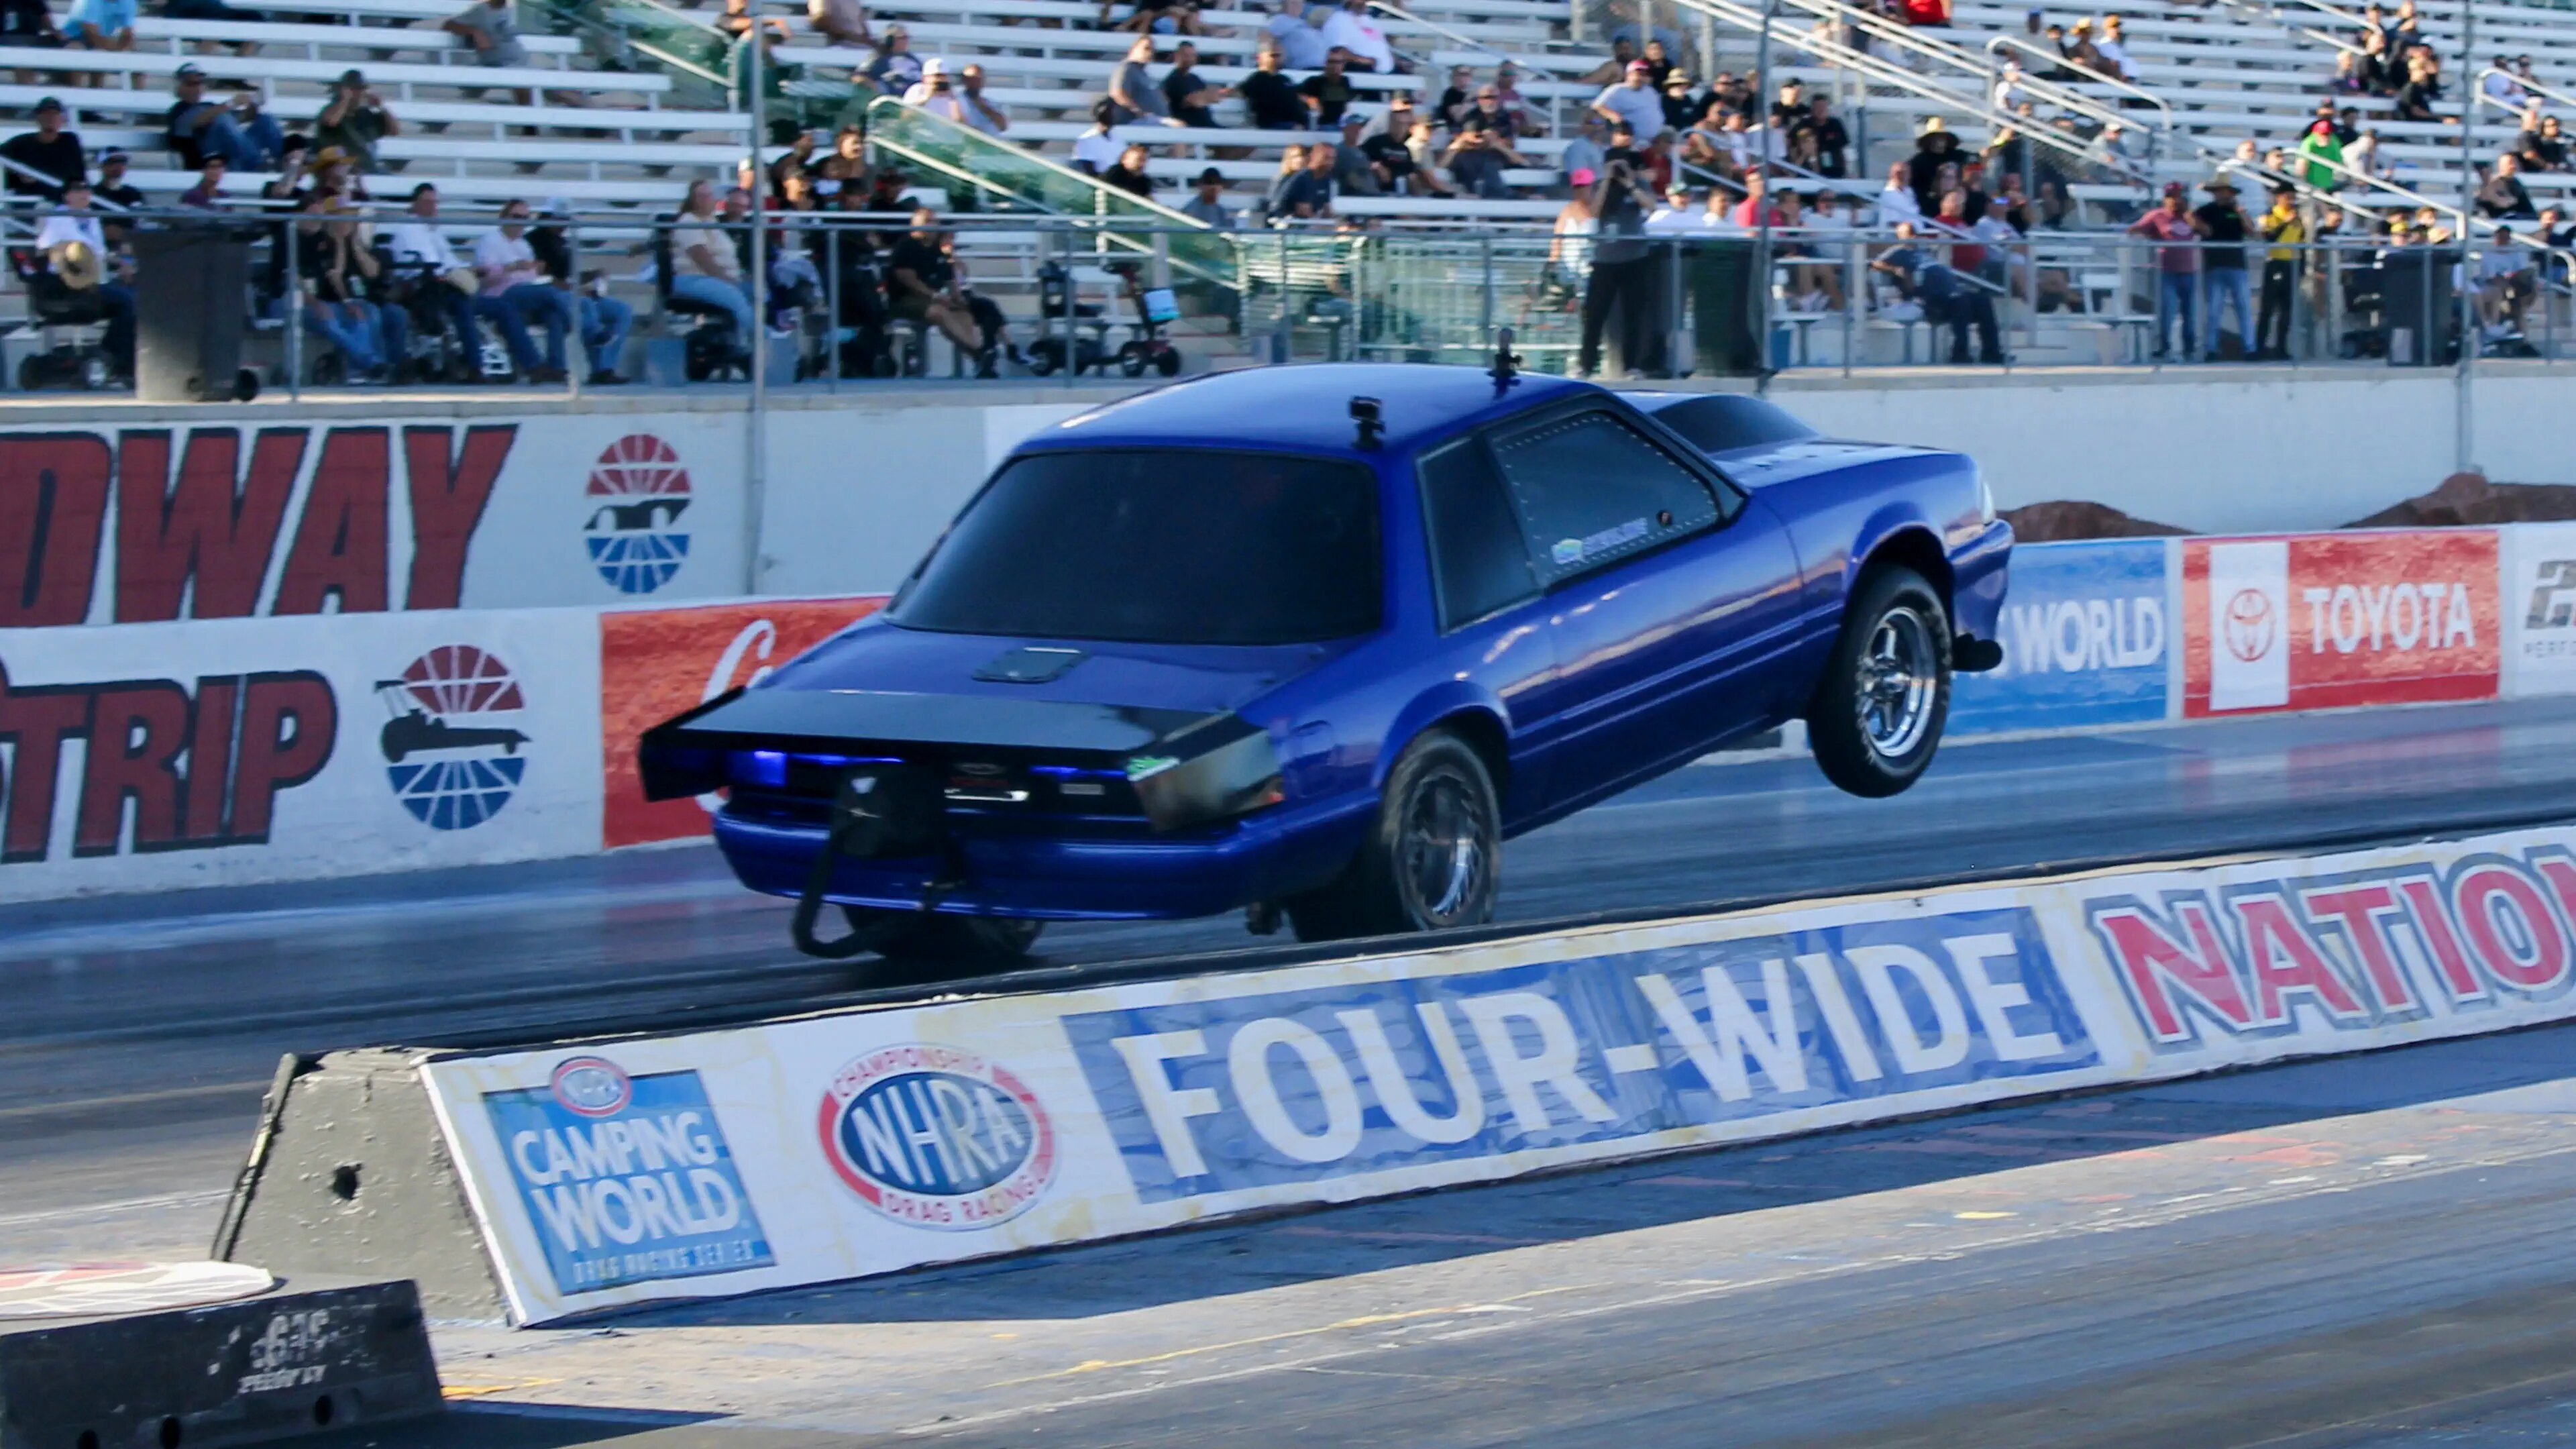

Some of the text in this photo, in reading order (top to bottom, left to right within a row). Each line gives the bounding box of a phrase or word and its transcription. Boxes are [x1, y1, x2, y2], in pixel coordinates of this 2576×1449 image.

[2013, 596, 2165, 674] WORLD
[2303, 582, 2476, 655] TOYOTA
[0, 656, 338, 864] TRIP
[1112, 932, 2065, 1179] FOUR-WIDE
[511, 1111, 718, 1186] CAMPING
[851, 1078, 1025, 1186] NHRA
[530, 1168, 739, 1253] WORLD
